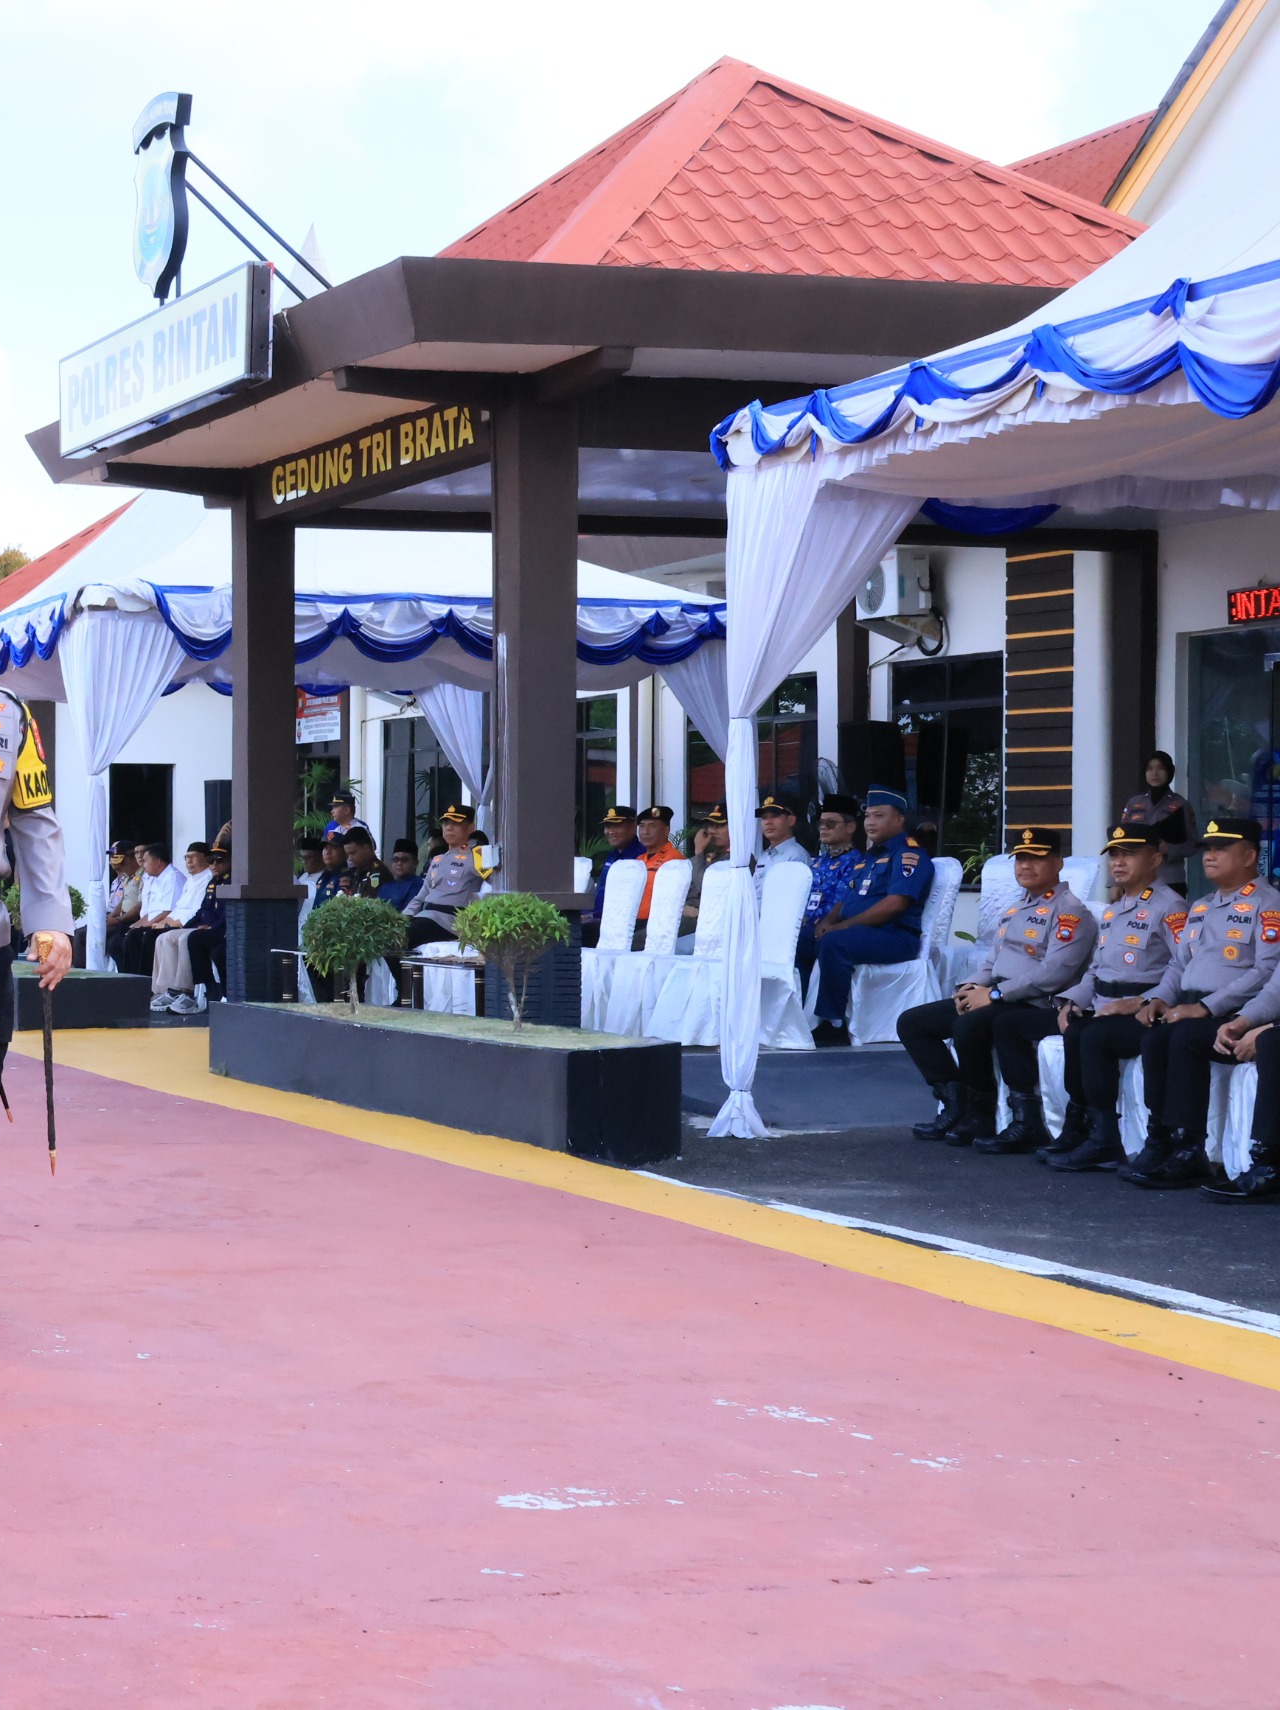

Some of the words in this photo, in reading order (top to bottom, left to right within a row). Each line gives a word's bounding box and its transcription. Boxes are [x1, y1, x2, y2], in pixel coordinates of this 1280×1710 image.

[67, 340, 145, 432] POLRES
[153, 291, 238, 394] BINTAN
[272, 442, 353, 505] GEDUNG
[359, 429, 392, 478] TRI
[400, 406, 474, 466] BRATA
[1026, 916, 1047, 926] POLRI
[1126, 920, 1149, 931] POLRI
[1226, 915, 1252, 925] POLRI
